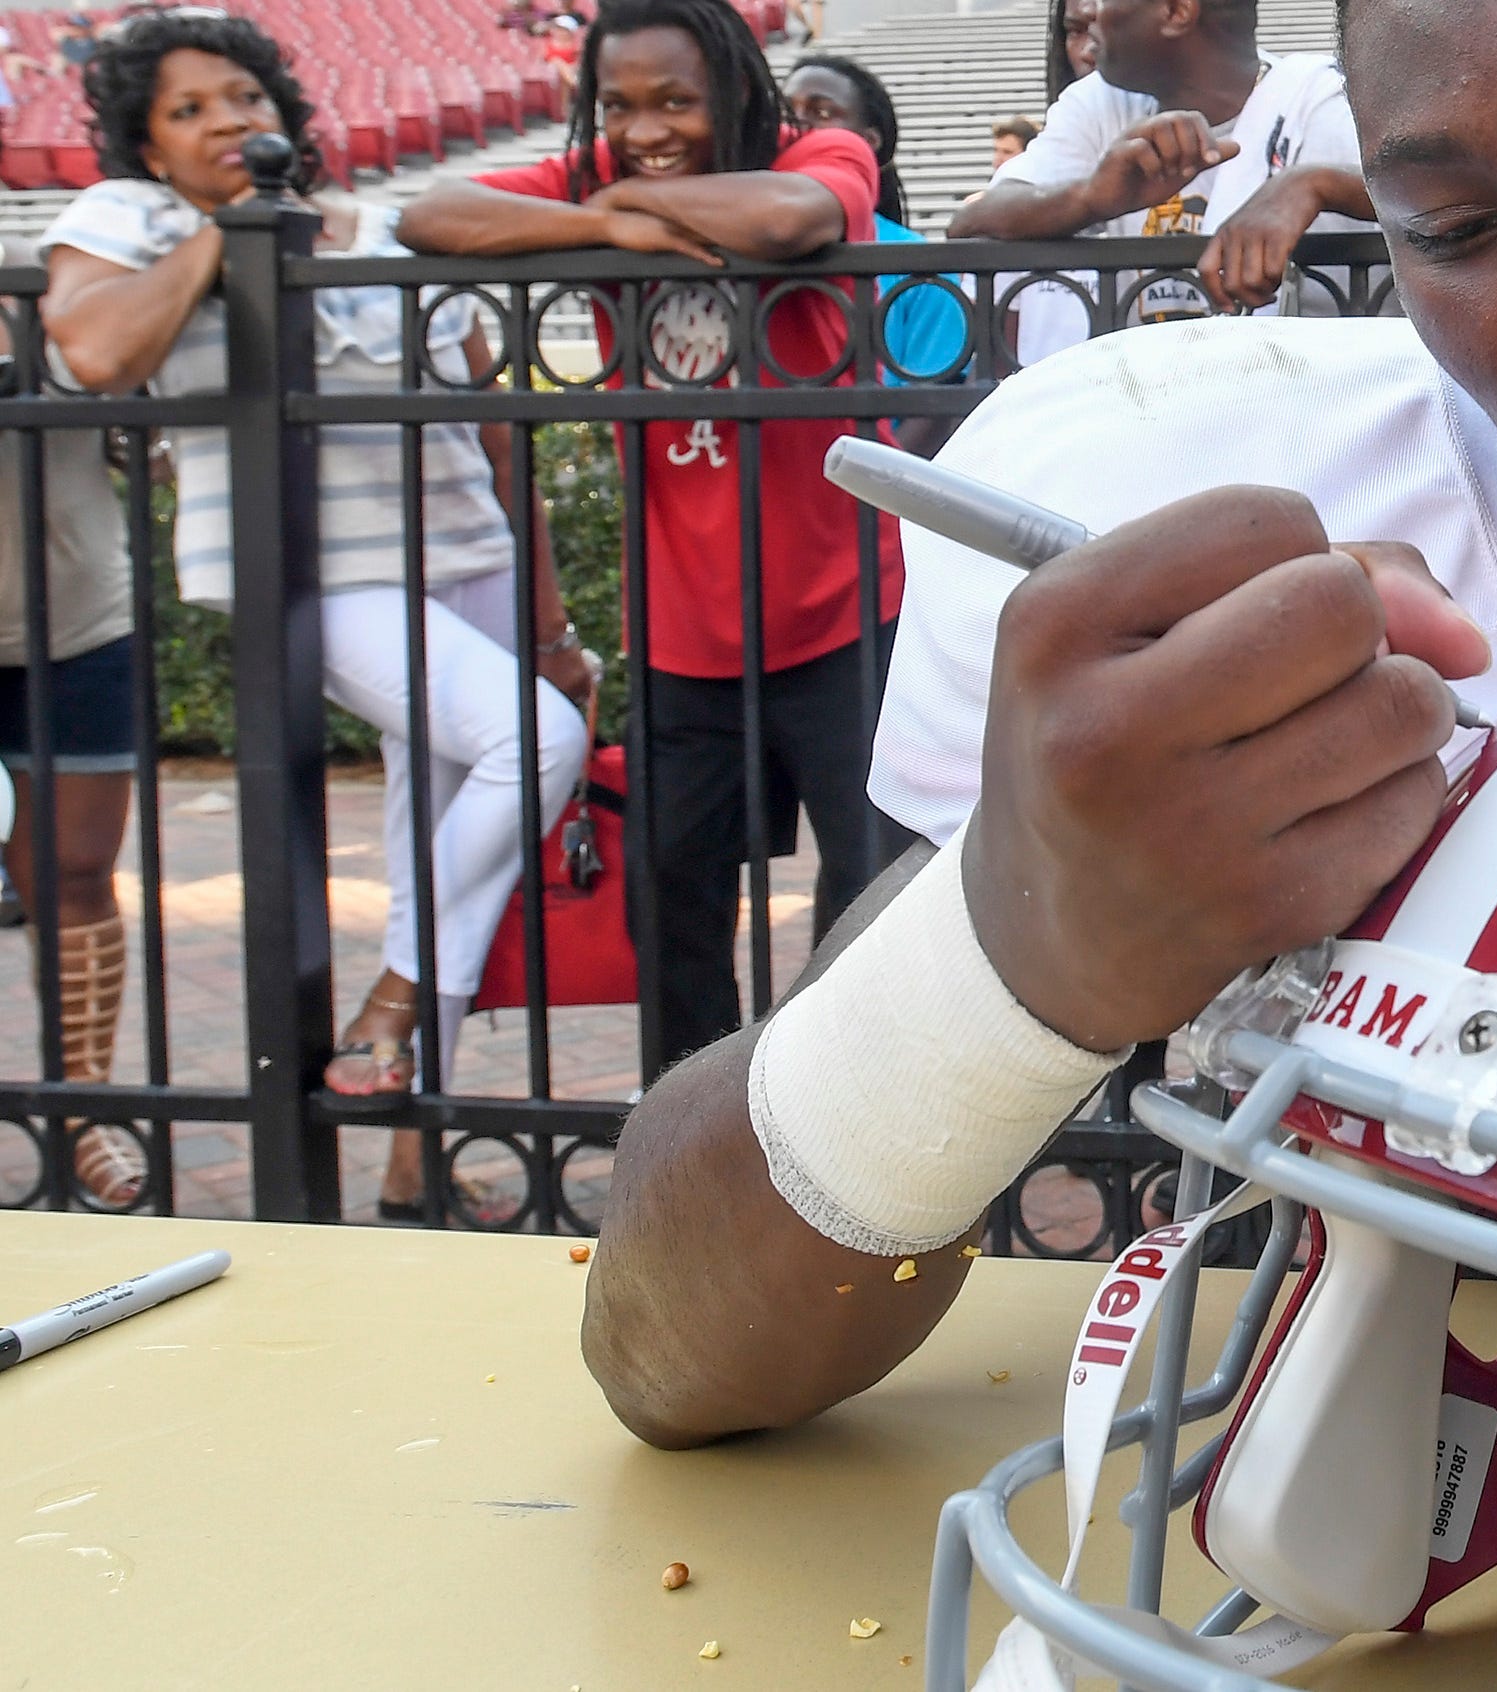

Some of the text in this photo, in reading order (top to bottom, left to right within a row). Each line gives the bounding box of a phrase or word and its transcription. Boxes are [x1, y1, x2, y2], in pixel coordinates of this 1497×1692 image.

[1305, 970, 1444, 1057] BAM
[1078, 1215, 1198, 1368] ddell
[1432, 1444, 1468, 1537] 9999947887
